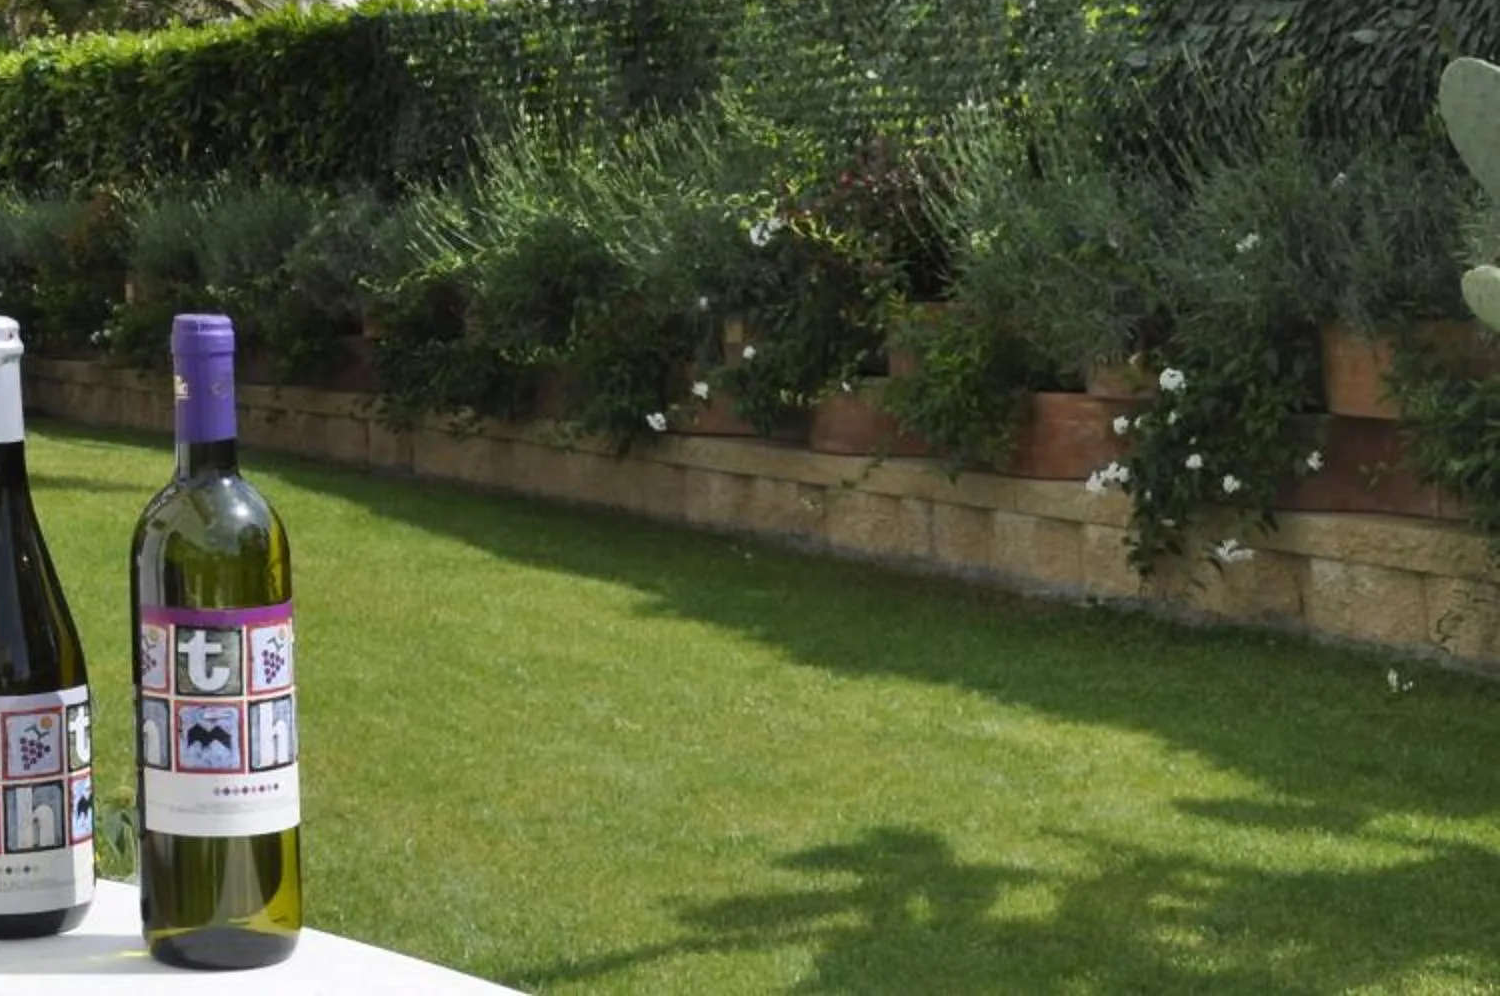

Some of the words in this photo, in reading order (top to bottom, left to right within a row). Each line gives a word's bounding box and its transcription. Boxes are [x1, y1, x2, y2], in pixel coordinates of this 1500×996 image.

[178, 630, 232, 692] t
[259, 702, 291, 769] h
[15, 787, 56, 849] h
